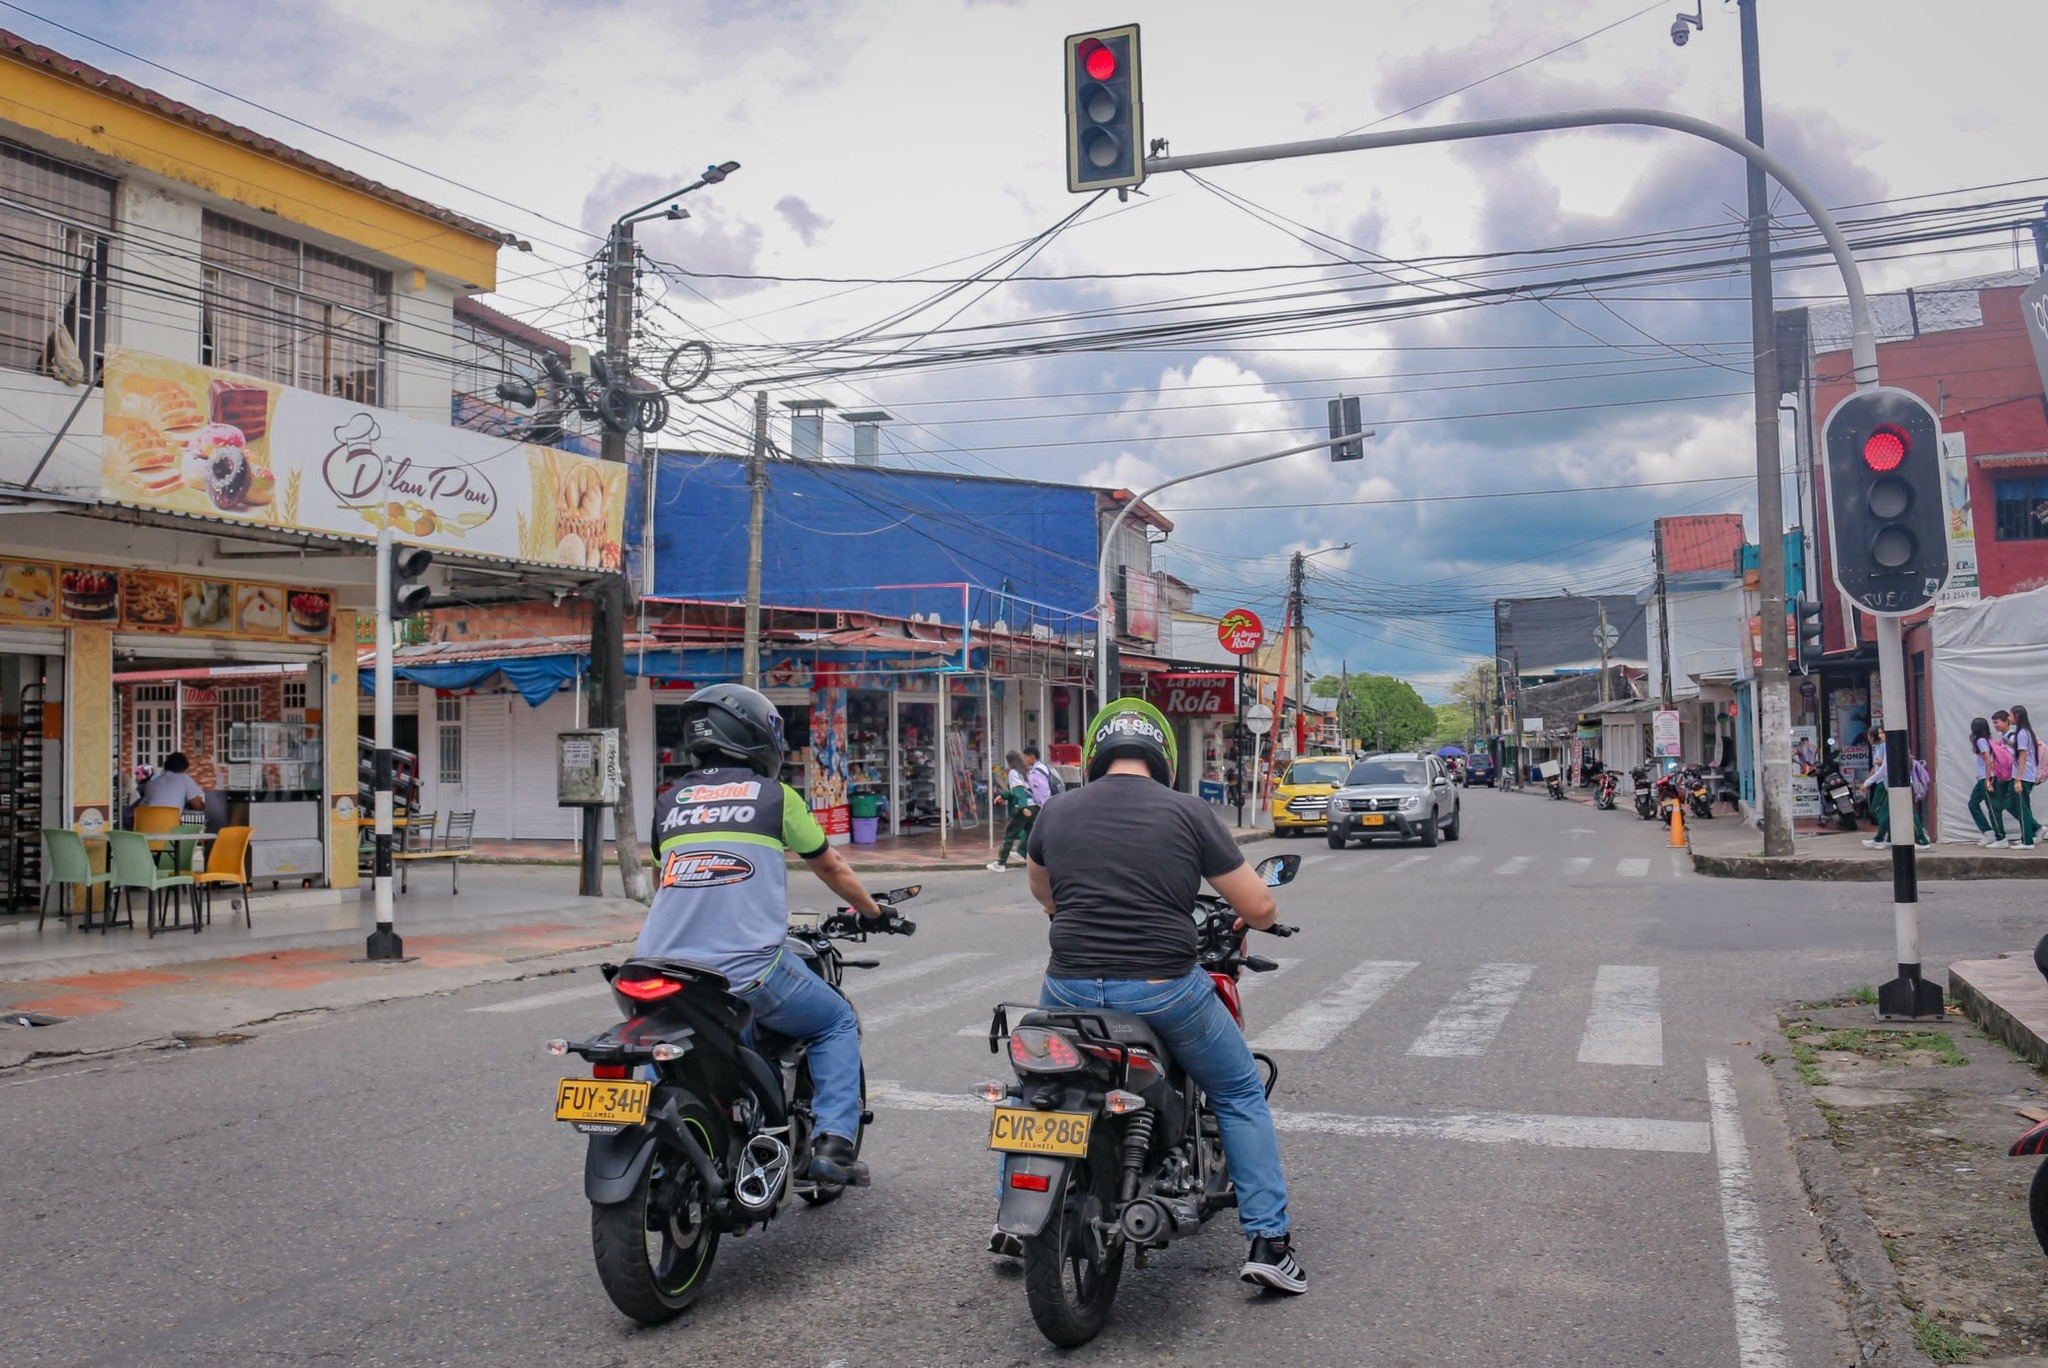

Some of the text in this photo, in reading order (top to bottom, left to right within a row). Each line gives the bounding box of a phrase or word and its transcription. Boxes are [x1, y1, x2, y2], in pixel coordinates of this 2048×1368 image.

[429, 467, 490, 505] Pan
[1231, 638, 1256, 648] Rola
[1167, 678, 1226, 688] La Brasa
[1166, 689, 1220, 712] Rola
[1096, 719, 1128, 742] CVR
[693, 784, 750, 800] Castrol
[660, 804, 755, 832] Actevo
[560, 1086, 644, 1113] FUY 34H
[582, 1111, 615, 1119] COLOMBIA
[995, 1115, 1085, 1145] CVR 98G
[1020, 1142, 1054, 1150] COLOMBIA
